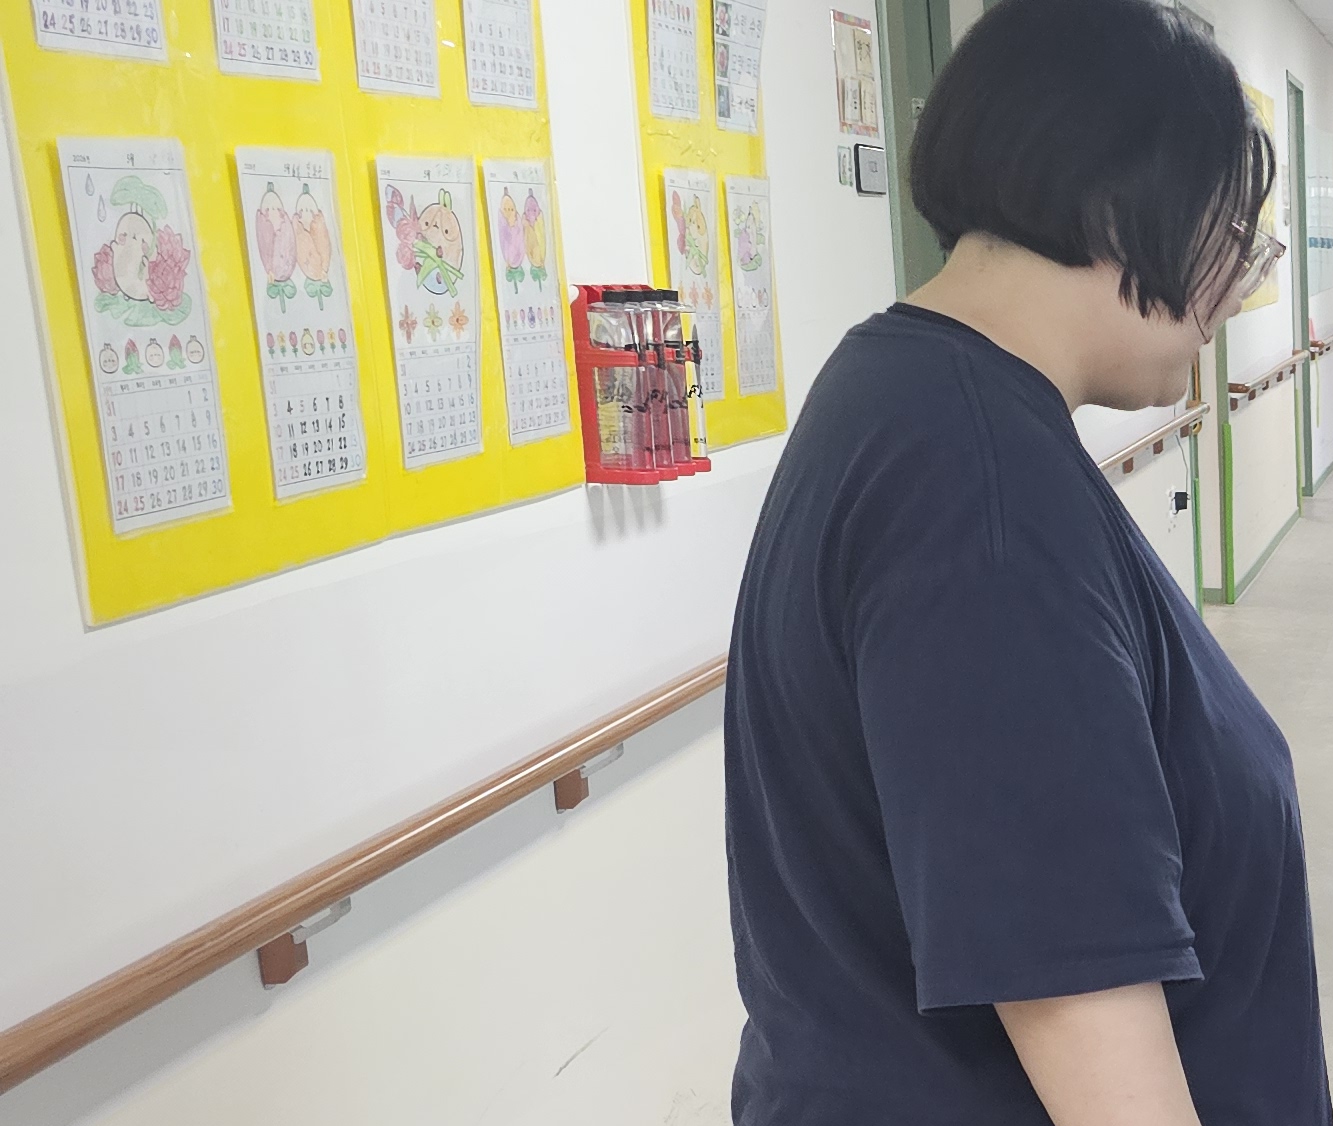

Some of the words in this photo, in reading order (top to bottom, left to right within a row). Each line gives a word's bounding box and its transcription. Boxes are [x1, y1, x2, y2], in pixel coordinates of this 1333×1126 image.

[62, 14, 75, 34] 25
[80, 18, 92, 35] 26
[98, 20, 108, 36] 27
[130, 24, 141, 42] 29
[238, 42, 246, 57] 25
[404, 384, 407, 396] 3
[415, 382, 418, 394] 4
[426, 380, 430, 392] 5
[438, 379, 441, 392] 6
[448, 378, 451, 390] 7
[106, 401, 116, 417] 31
[202, 387, 208, 402] 2
[287, 400, 293, 414] 4
[313, 397, 317, 412] 6
[326, 397, 329, 411] 7
[339, 395, 343, 409] 8
[404, 403, 411, 415] 10
[426, 400, 433, 410] 12
[438, 398, 444, 410] 13
[111, 426, 117, 442] 3
[128, 424, 134, 438] 4
[144, 421, 150, 436] 5
[160, 416, 166, 433] 6
[175, 415, 180, 430] 7
[191, 410, 196, 428] 8
[206, 410, 211, 425] 9
[288, 424, 295, 438] 11
[300, 421, 307, 434] 12
[312, 419, 319, 433] 13
[325, 418, 332, 432] 14
[339, 413, 345, 431] 15
[407, 422, 412, 435] 17
[438, 416, 446, 429] 20
[112, 451, 122, 466] 10
[130, 448, 138, 463] 11
[145, 445, 155, 460] 12
[161, 442, 171, 457] 13
[176, 439, 186, 454] 14
[192, 435, 201, 451] 15
[207, 433, 217, 449] 16
[290, 443, 297, 459] 18
[302, 443, 309, 456] 19
[314, 440, 322, 453] 20
[327, 438, 333, 451] 21
[339, 437, 347, 449] 22
[418, 440, 426, 451] 25
[429, 437, 437, 449] 26
[441, 436, 446, 447] 27
[116, 475, 124, 491] 17
[131, 472, 142, 487] 18
[149, 469, 158, 485] 19
[164, 465, 175, 481] 20
[180, 461, 189, 477] 21
[195, 459, 206, 474] 22
[210, 456, 219, 470] 23
[303, 461, 311, 476] 26
[316, 461, 323, 474] 27
[328, 459, 336, 472] 28
[340, 457, 348, 470] 29
[118, 499, 128, 515] 24
[134, 496, 145, 511] 25
[151, 492, 162, 509] 26
[167, 489, 177, 504] 27
[182, 484, 192, 501] 28
[198, 481, 207, 497] 29
[212, 479, 223, 494] 30
